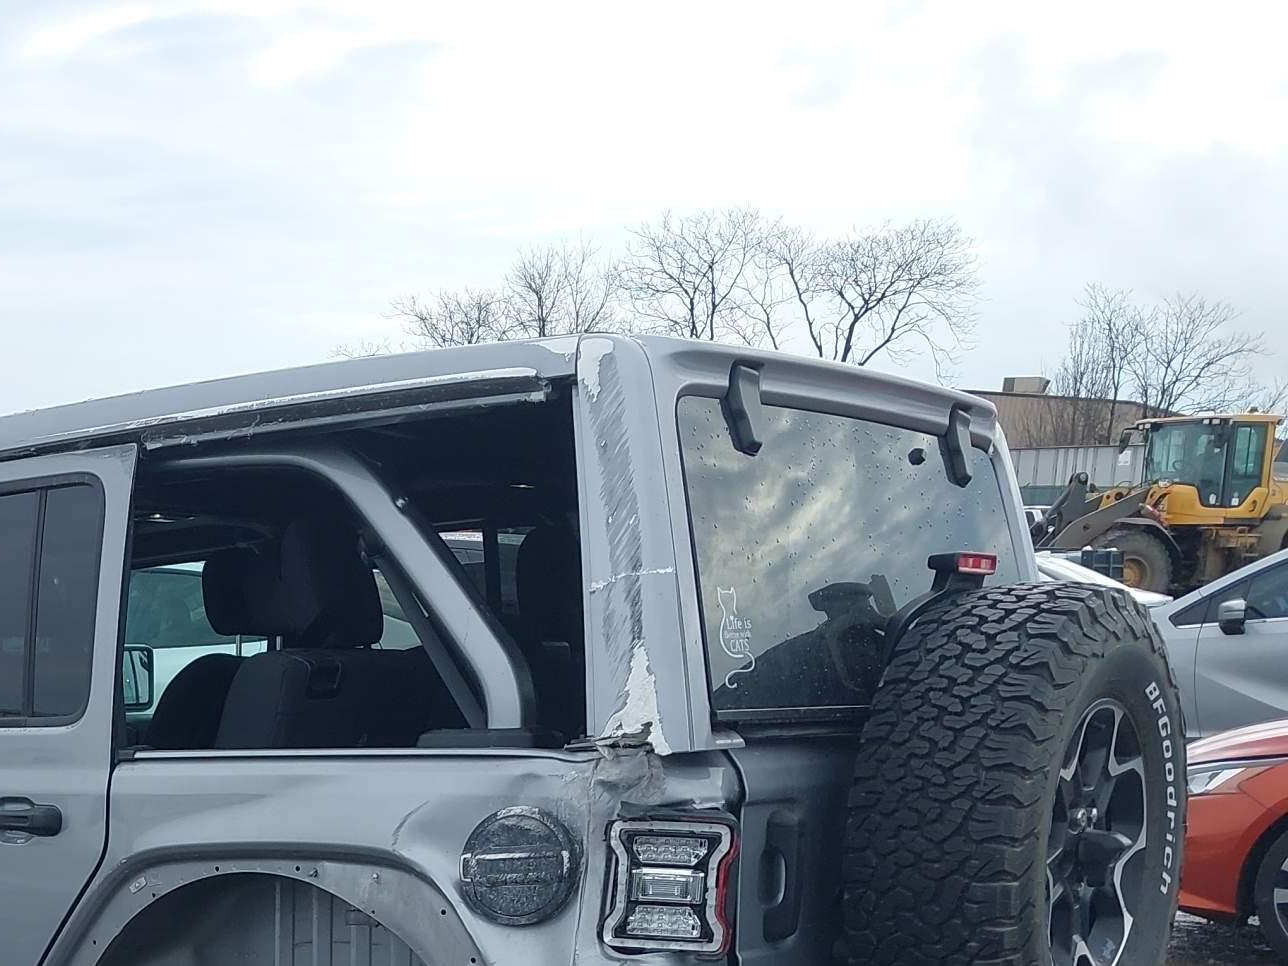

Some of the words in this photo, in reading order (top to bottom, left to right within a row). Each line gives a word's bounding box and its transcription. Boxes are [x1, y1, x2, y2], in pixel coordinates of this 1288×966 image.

[726, 616, 742, 630] Life
[730, 639, 750, 652] CATS
[1144, 681, 1177, 895] BFGoodrich
